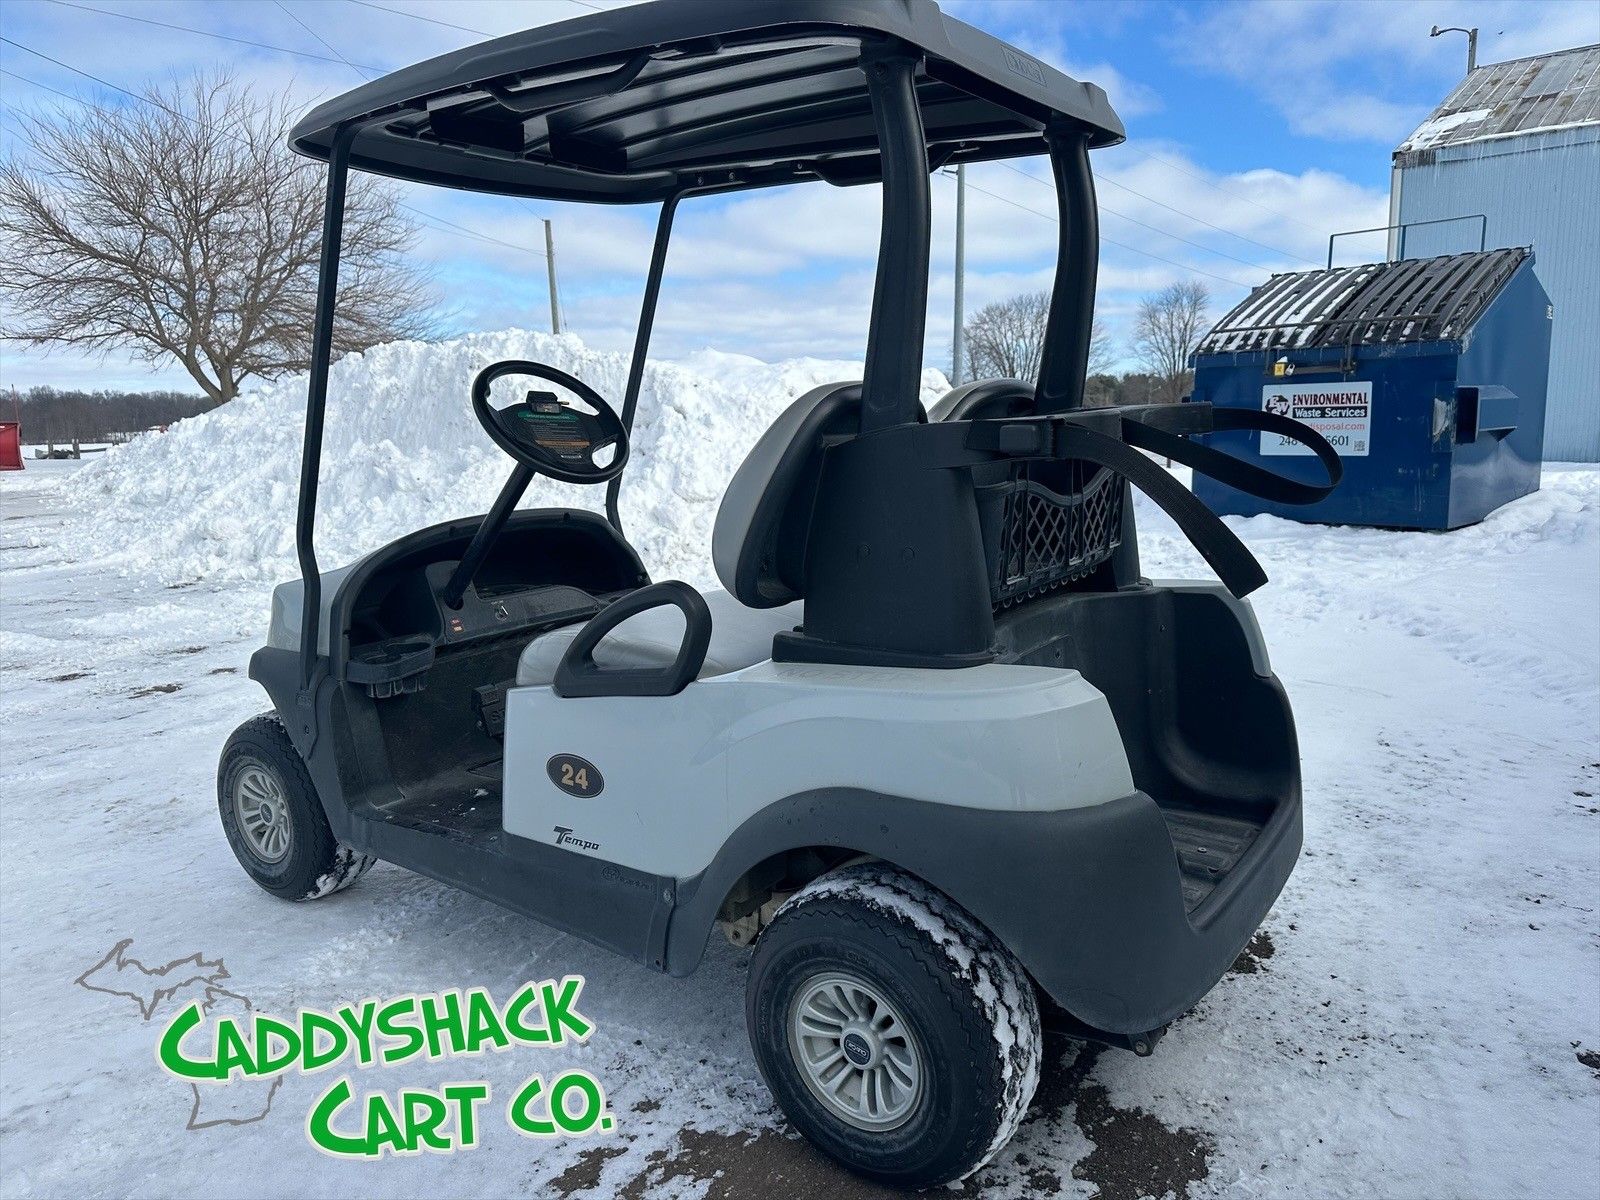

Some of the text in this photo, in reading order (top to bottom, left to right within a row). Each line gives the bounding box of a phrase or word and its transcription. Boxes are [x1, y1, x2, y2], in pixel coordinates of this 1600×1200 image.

[1292, 392, 1368, 406] ENVIRONMENTAL
[1294, 407, 1365, 418] Waste Services
[561, 763, 589, 790] 24
[553, 825, 600, 850] Tempo
